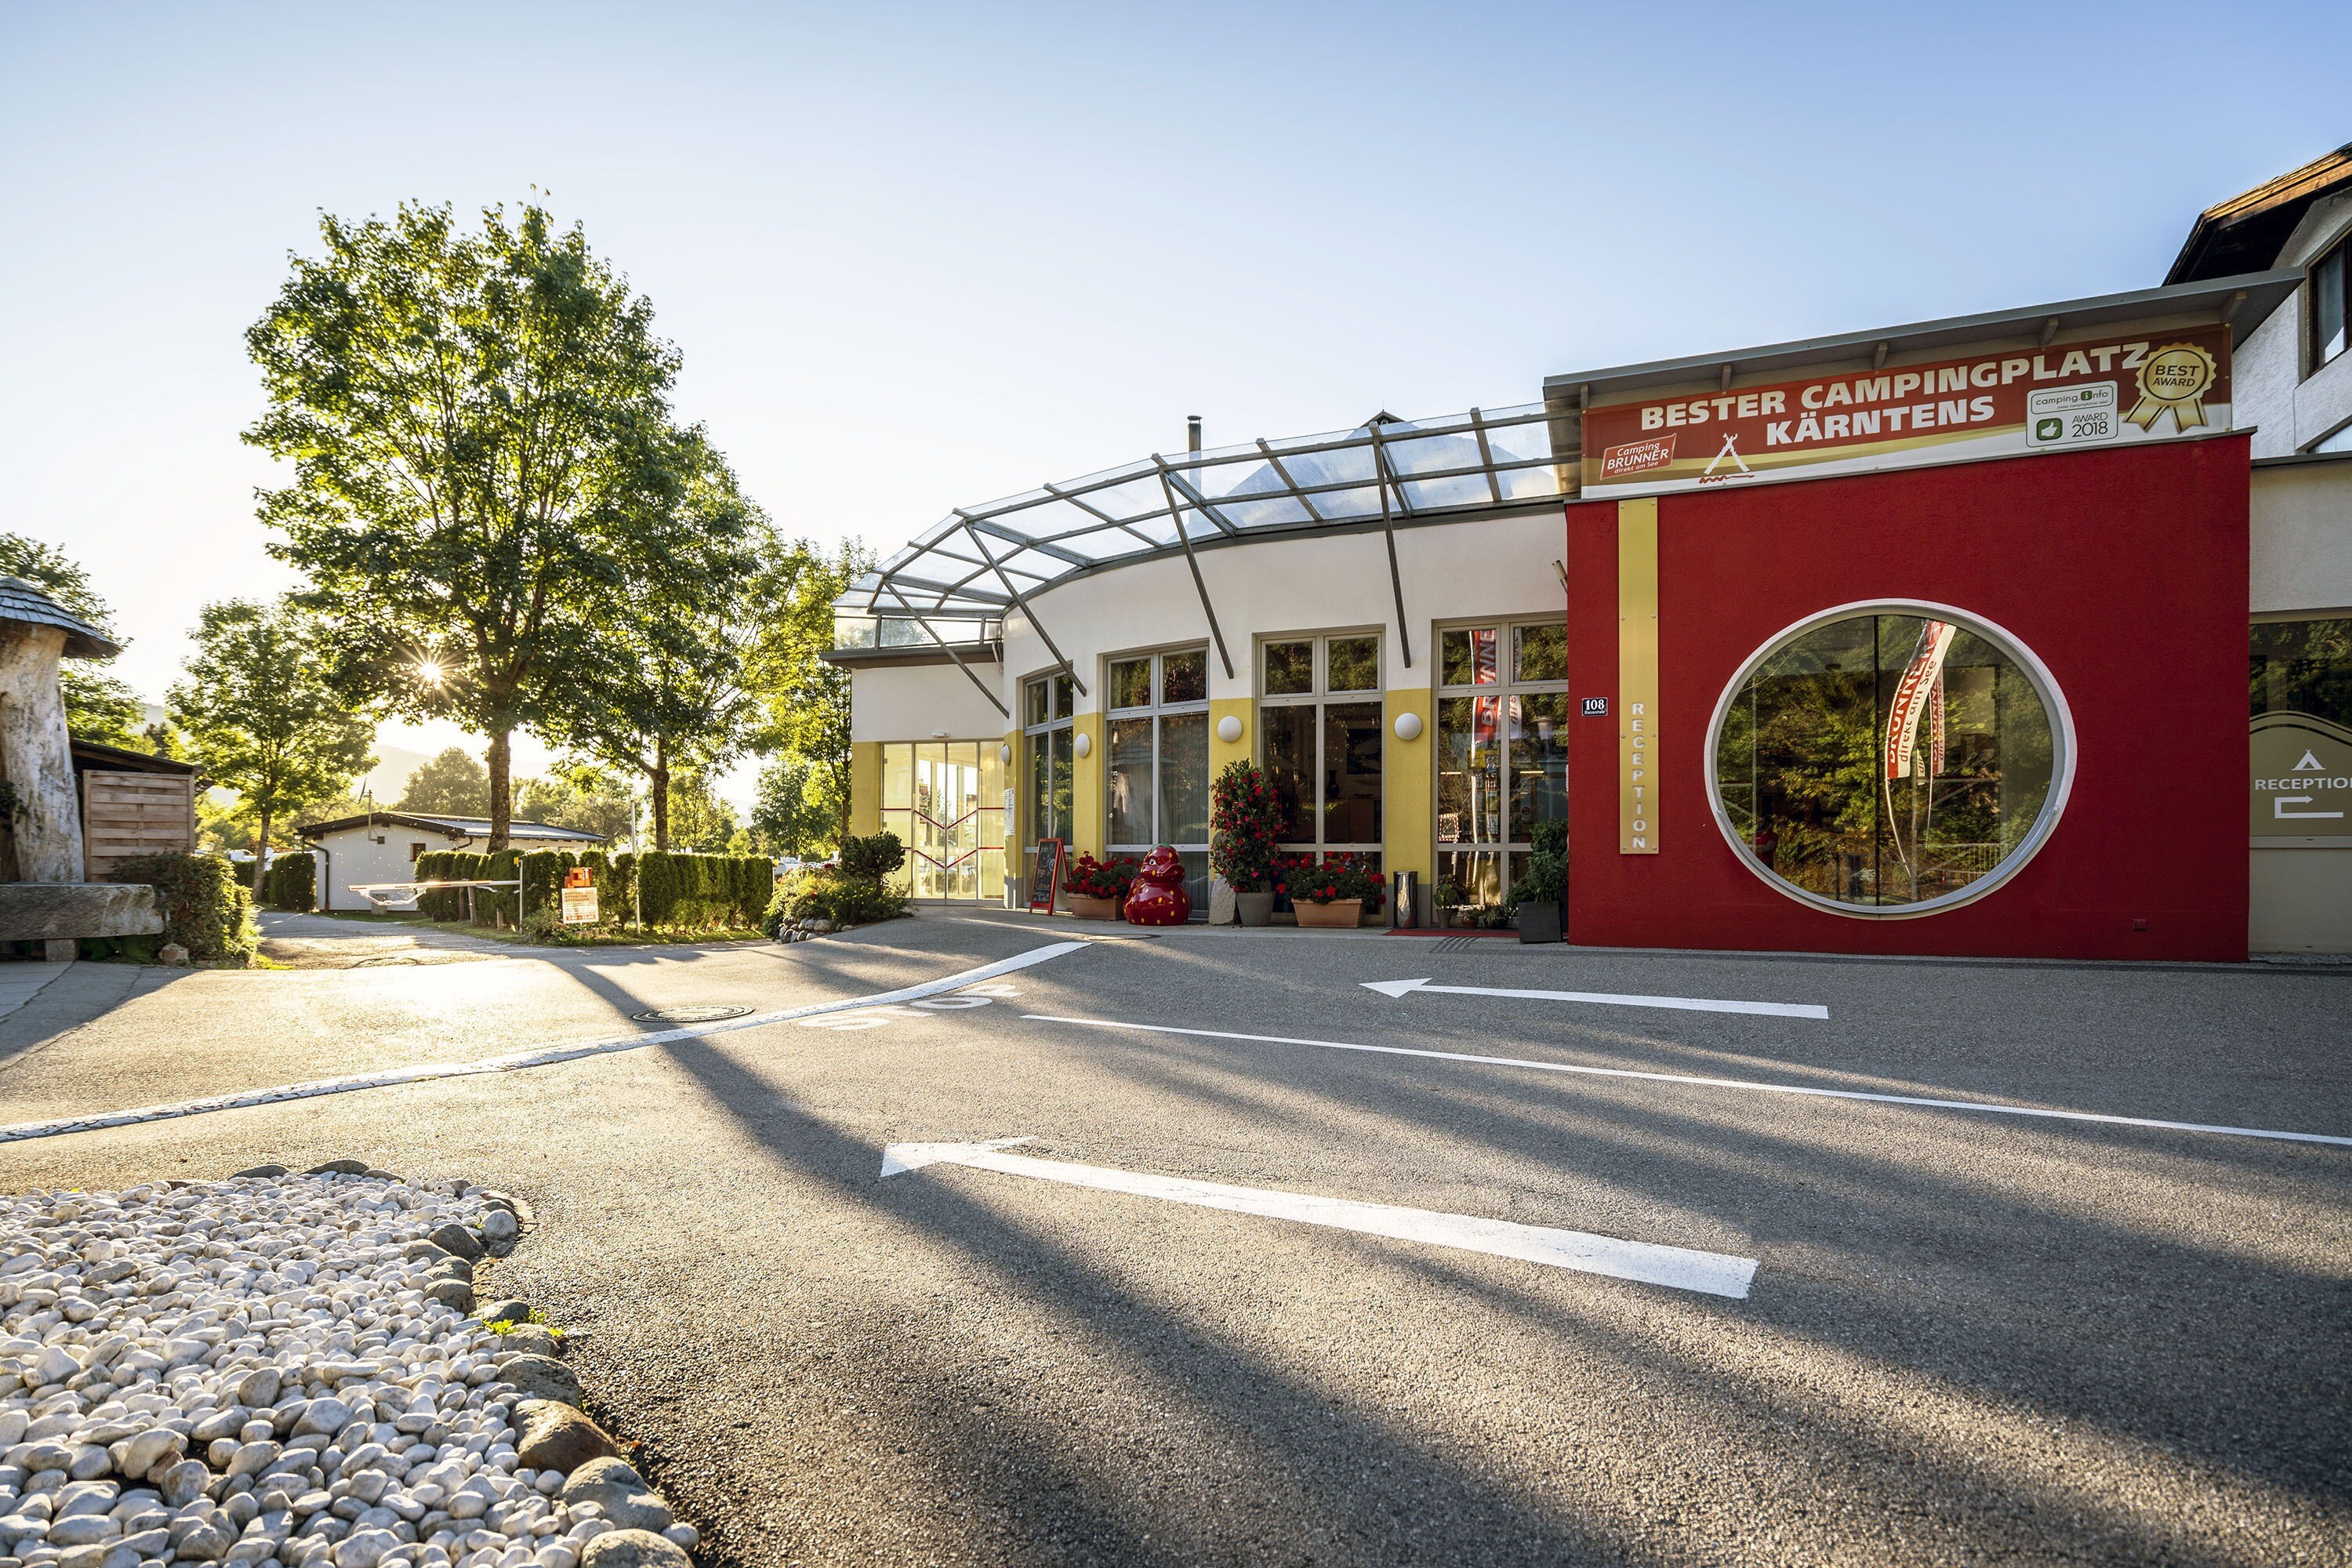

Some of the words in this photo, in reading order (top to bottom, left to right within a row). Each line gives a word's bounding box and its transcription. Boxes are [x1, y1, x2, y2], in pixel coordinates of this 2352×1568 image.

[2155, 365, 2200, 377] BEST
[1642, 390, 1786, 430] BESTER
[1801, 341, 2149, 409] CAMPINGPLATZ
[2152, 377, 2195, 387] AWARD
[2036, 390, 2108, 405] camping.info
[1766, 396, 1994, 445] KÄRNTENS
[2072, 412, 2108, 423] AWARD
[2072, 421, 2108, 437] 2018
[1617, 442, 1660, 456] Camping
[1607, 448, 1668, 470] BRUNNER
[1585, 699, 1605, 710] 108
[1899, 720, 1913, 762] direkt
[1909, 691, 1923, 715] am
[1920, 660, 1937, 685] See
[1632, 702, 1646, 848] RECEPTION
[2255, 777, 2352, 790] RECEPTIO
[798, 985, 1023, 1031] STOP
